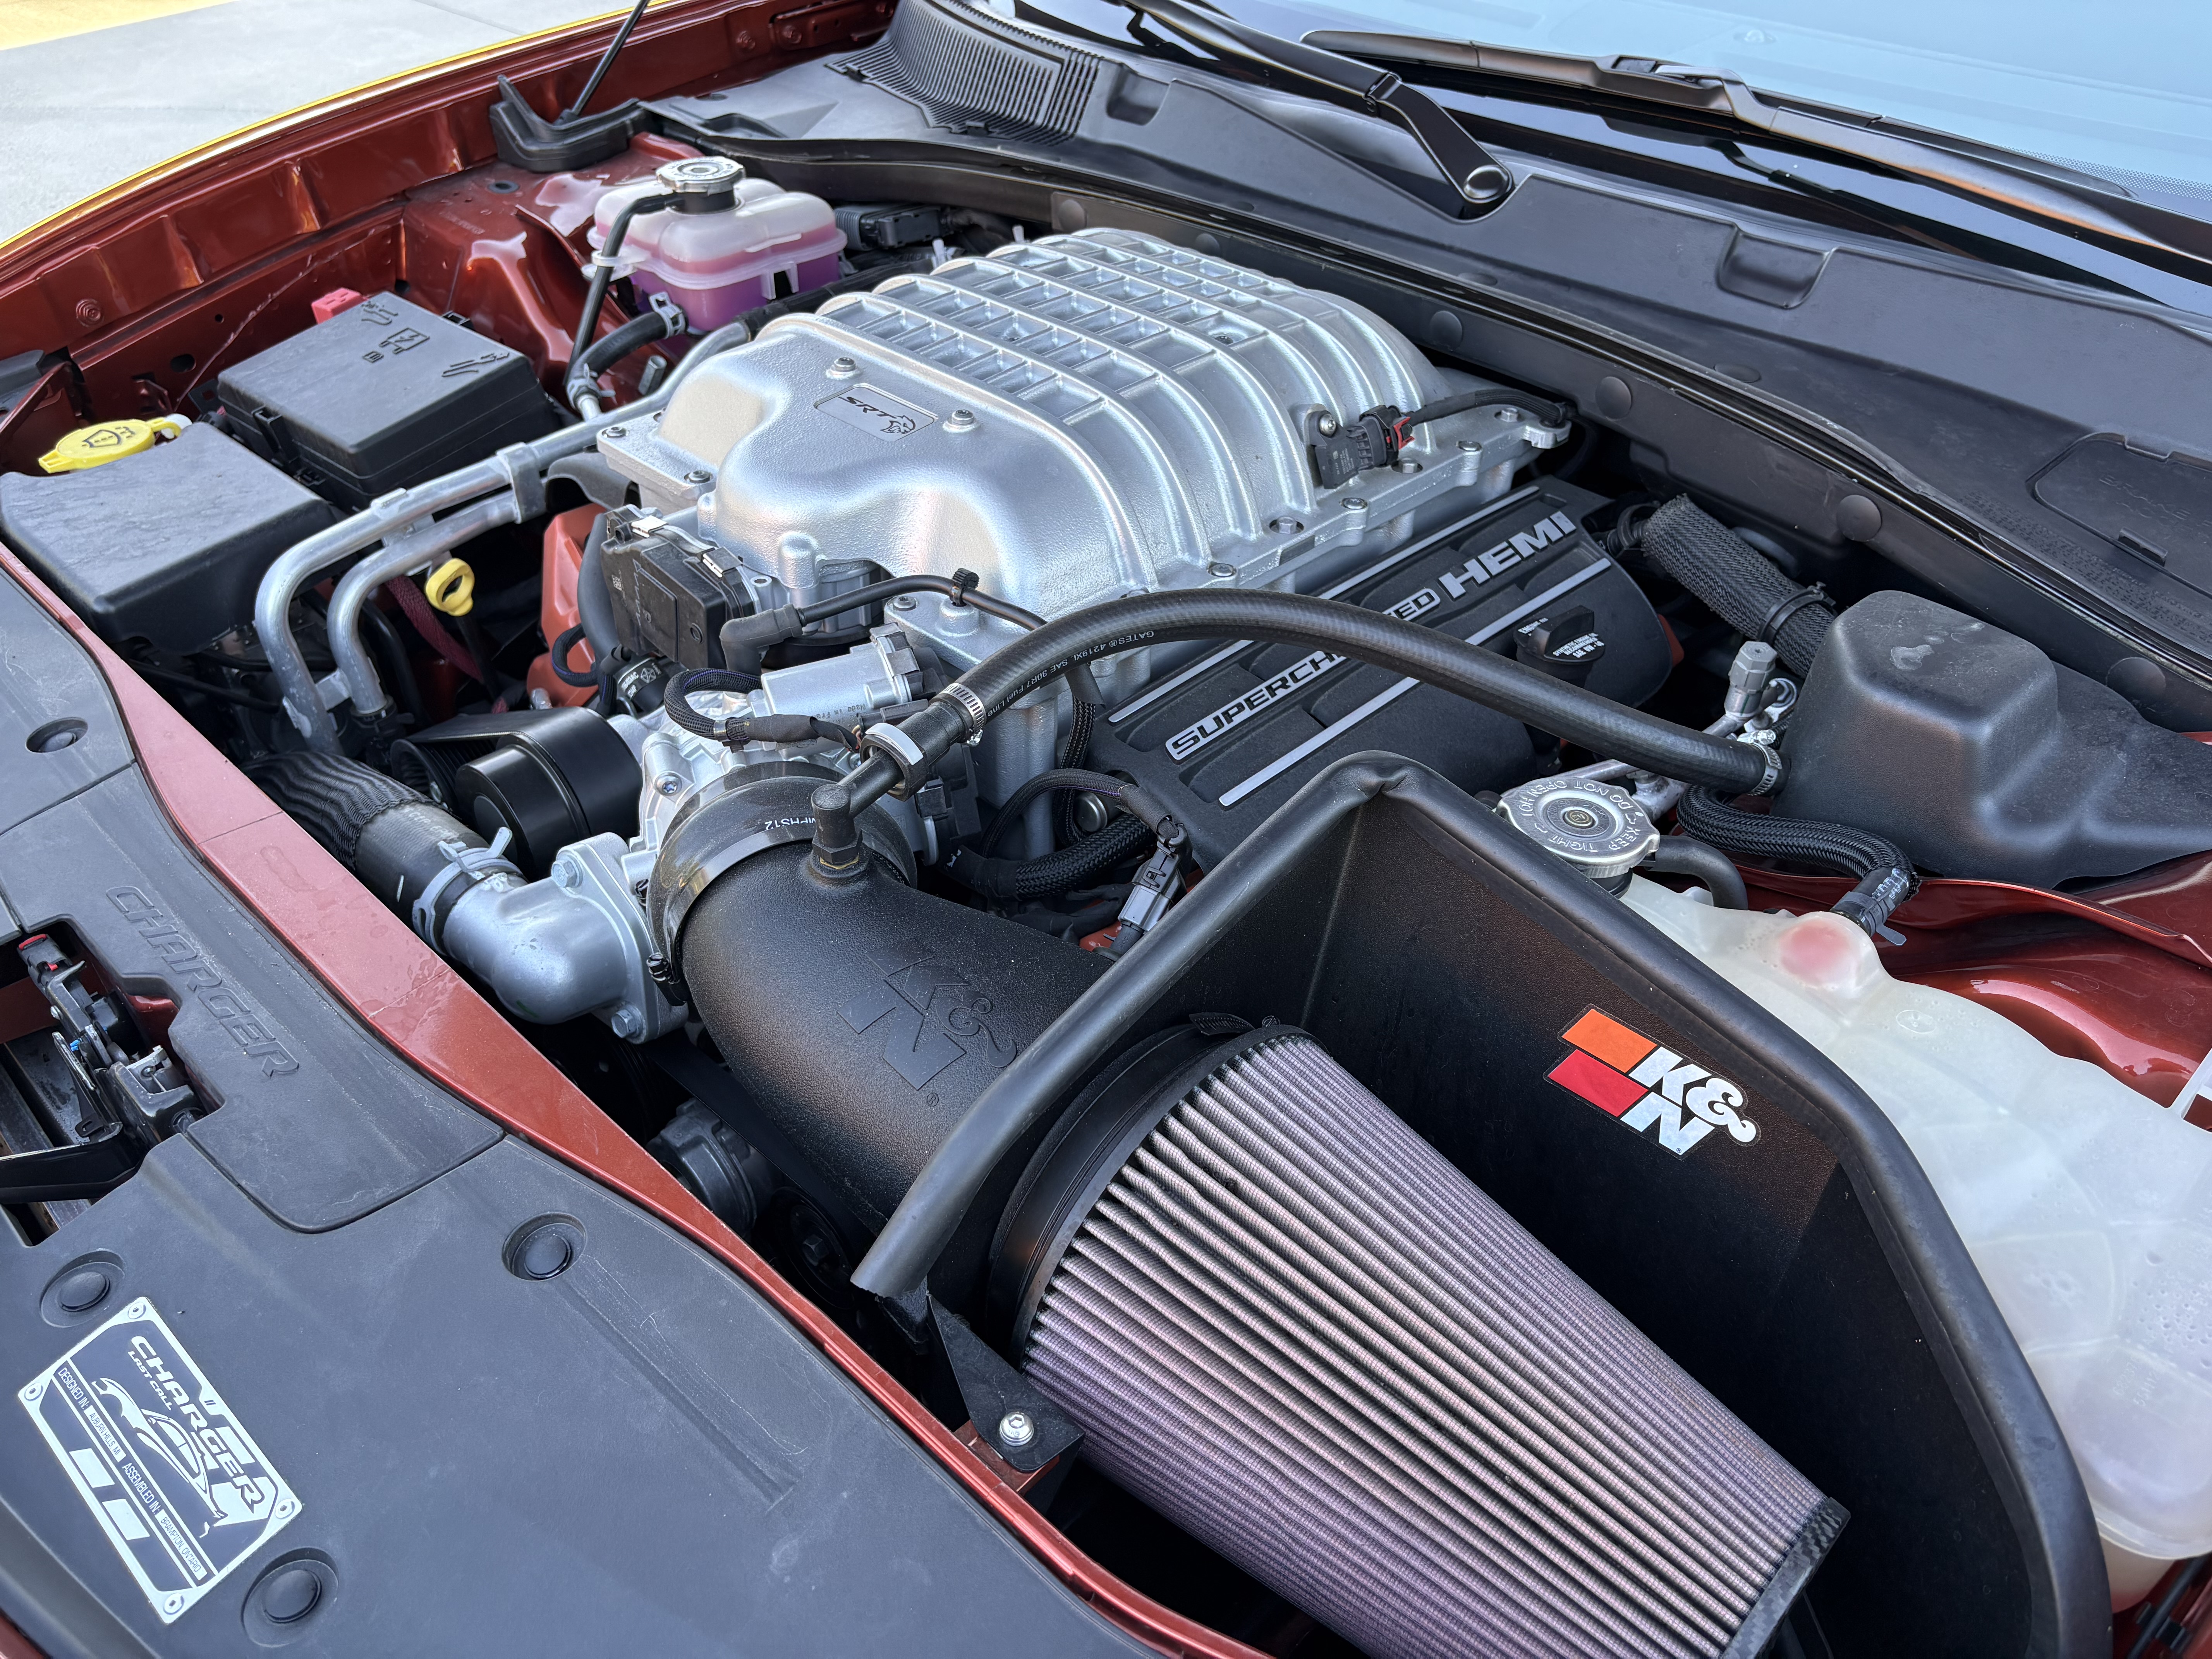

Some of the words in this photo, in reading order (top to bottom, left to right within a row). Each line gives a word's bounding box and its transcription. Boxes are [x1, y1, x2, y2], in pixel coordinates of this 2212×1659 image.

[838, 396, 896, 419] SRT
[1439, 511, 1576, 599] HEMI
[1070, 643, 1106, 661] 4219XL
[1050, 659, 1068, 673] SAE
[1172, 591, 1437, 756] SUPERCHED
[1027, 670, 1048, 689] 30R7
[1007, 685, 1024, 703] Fuel
[988, 700, 1005, 717] Line
[1527, 780, 1567, 797] OPEN
[1573, 780, 1610, 796] NOT
[1519, 797, 1535, 817] HOT
[1609, 794, 1633, 809] DO
[1548, 835, 1599, 853] TIGHT
[1608, 826, 1641, 850] KEEP
[106, 886, 299, 1077] CHARGER
[1620, 1046, 1756, 1156] K&N
[127, 1351, 153, 1379] LAST
[149, 1380, 172, 1411] CALL
[131, 1336, 264, 1510] CHARGER
[58, 1367, 84, 1400] DESIGNED
[78, 1396, 89, 1410] IN:
[89, 1413, 106, 1434] AUBURN
[102, 1432, 115, 1449] HILLS,
[113, 1446, 121, 1456] MI
[122, 1463, 155, 1504] ASSEMBLED
[149, 1500, 161, 1514] IN:
[160, 1516, 185, 1550] BRAMPTON,
[182, 1547, 201, 1572] ONTARIO
